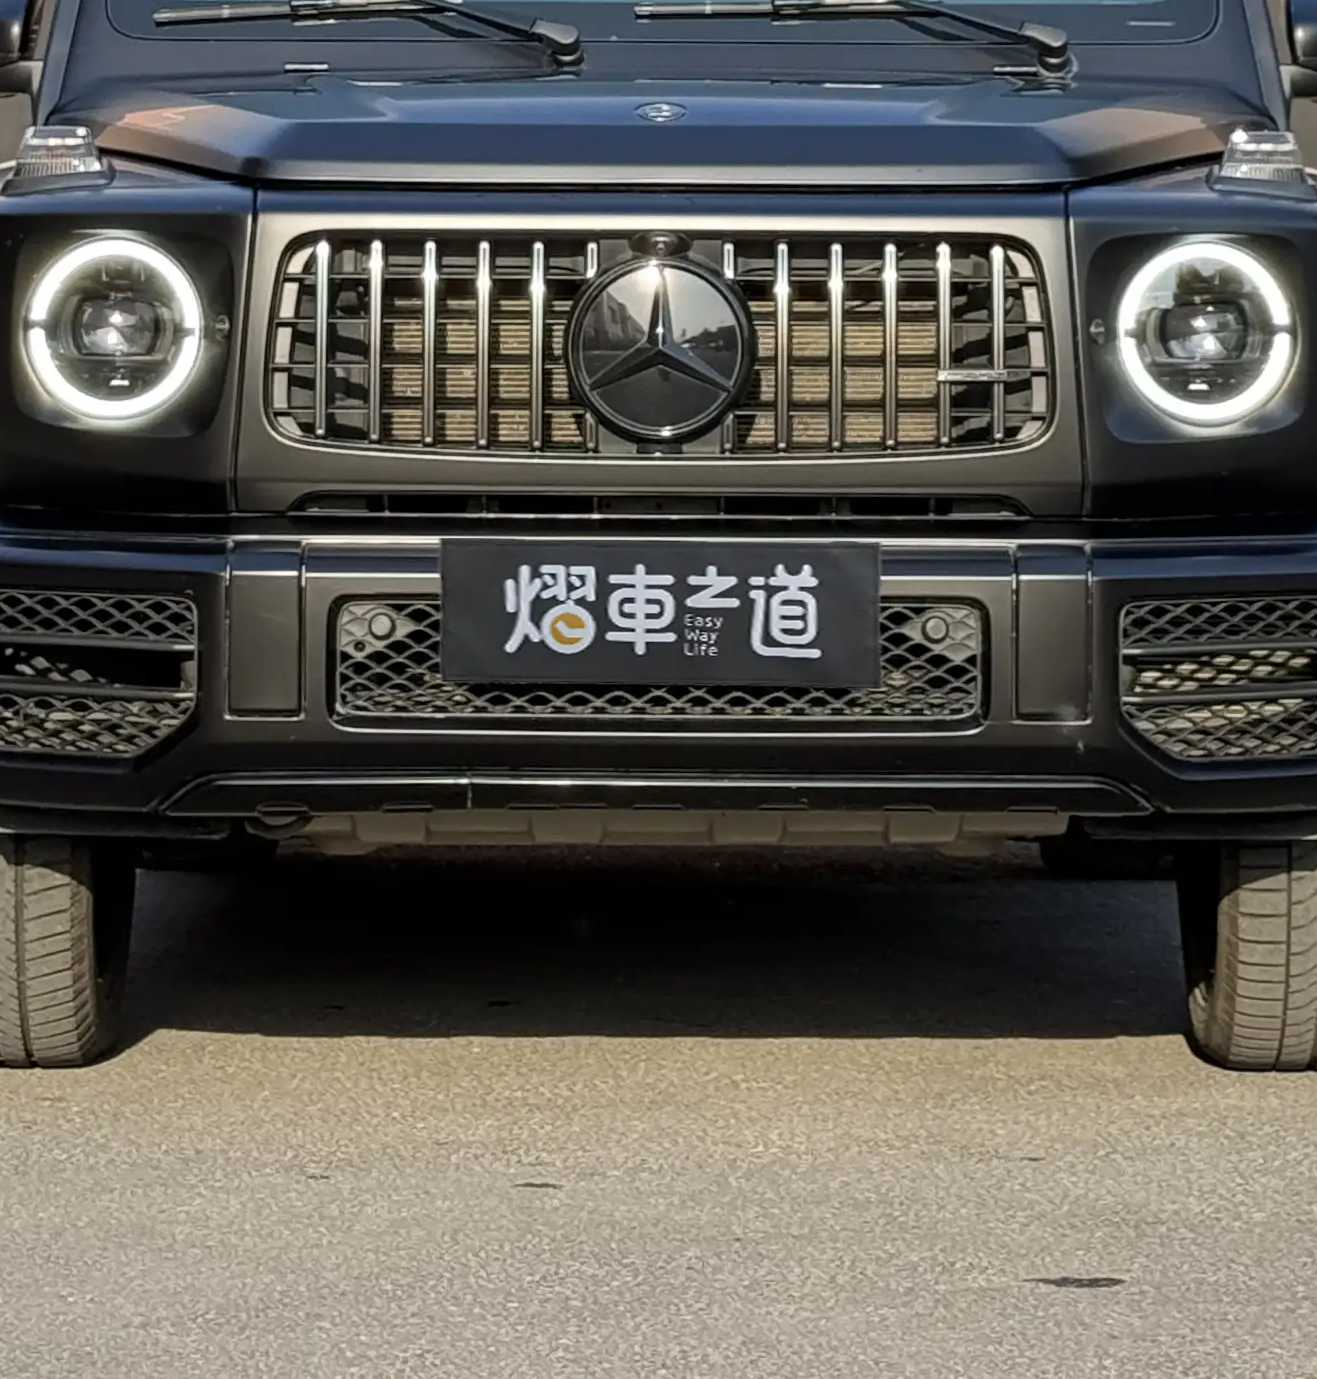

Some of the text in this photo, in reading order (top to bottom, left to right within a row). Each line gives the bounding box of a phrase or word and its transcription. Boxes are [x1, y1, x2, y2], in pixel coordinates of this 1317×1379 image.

[684, 613, 723, 629] Easy
[684, 628, 719, 644] Way
[684, 643, 719, 656] Life
